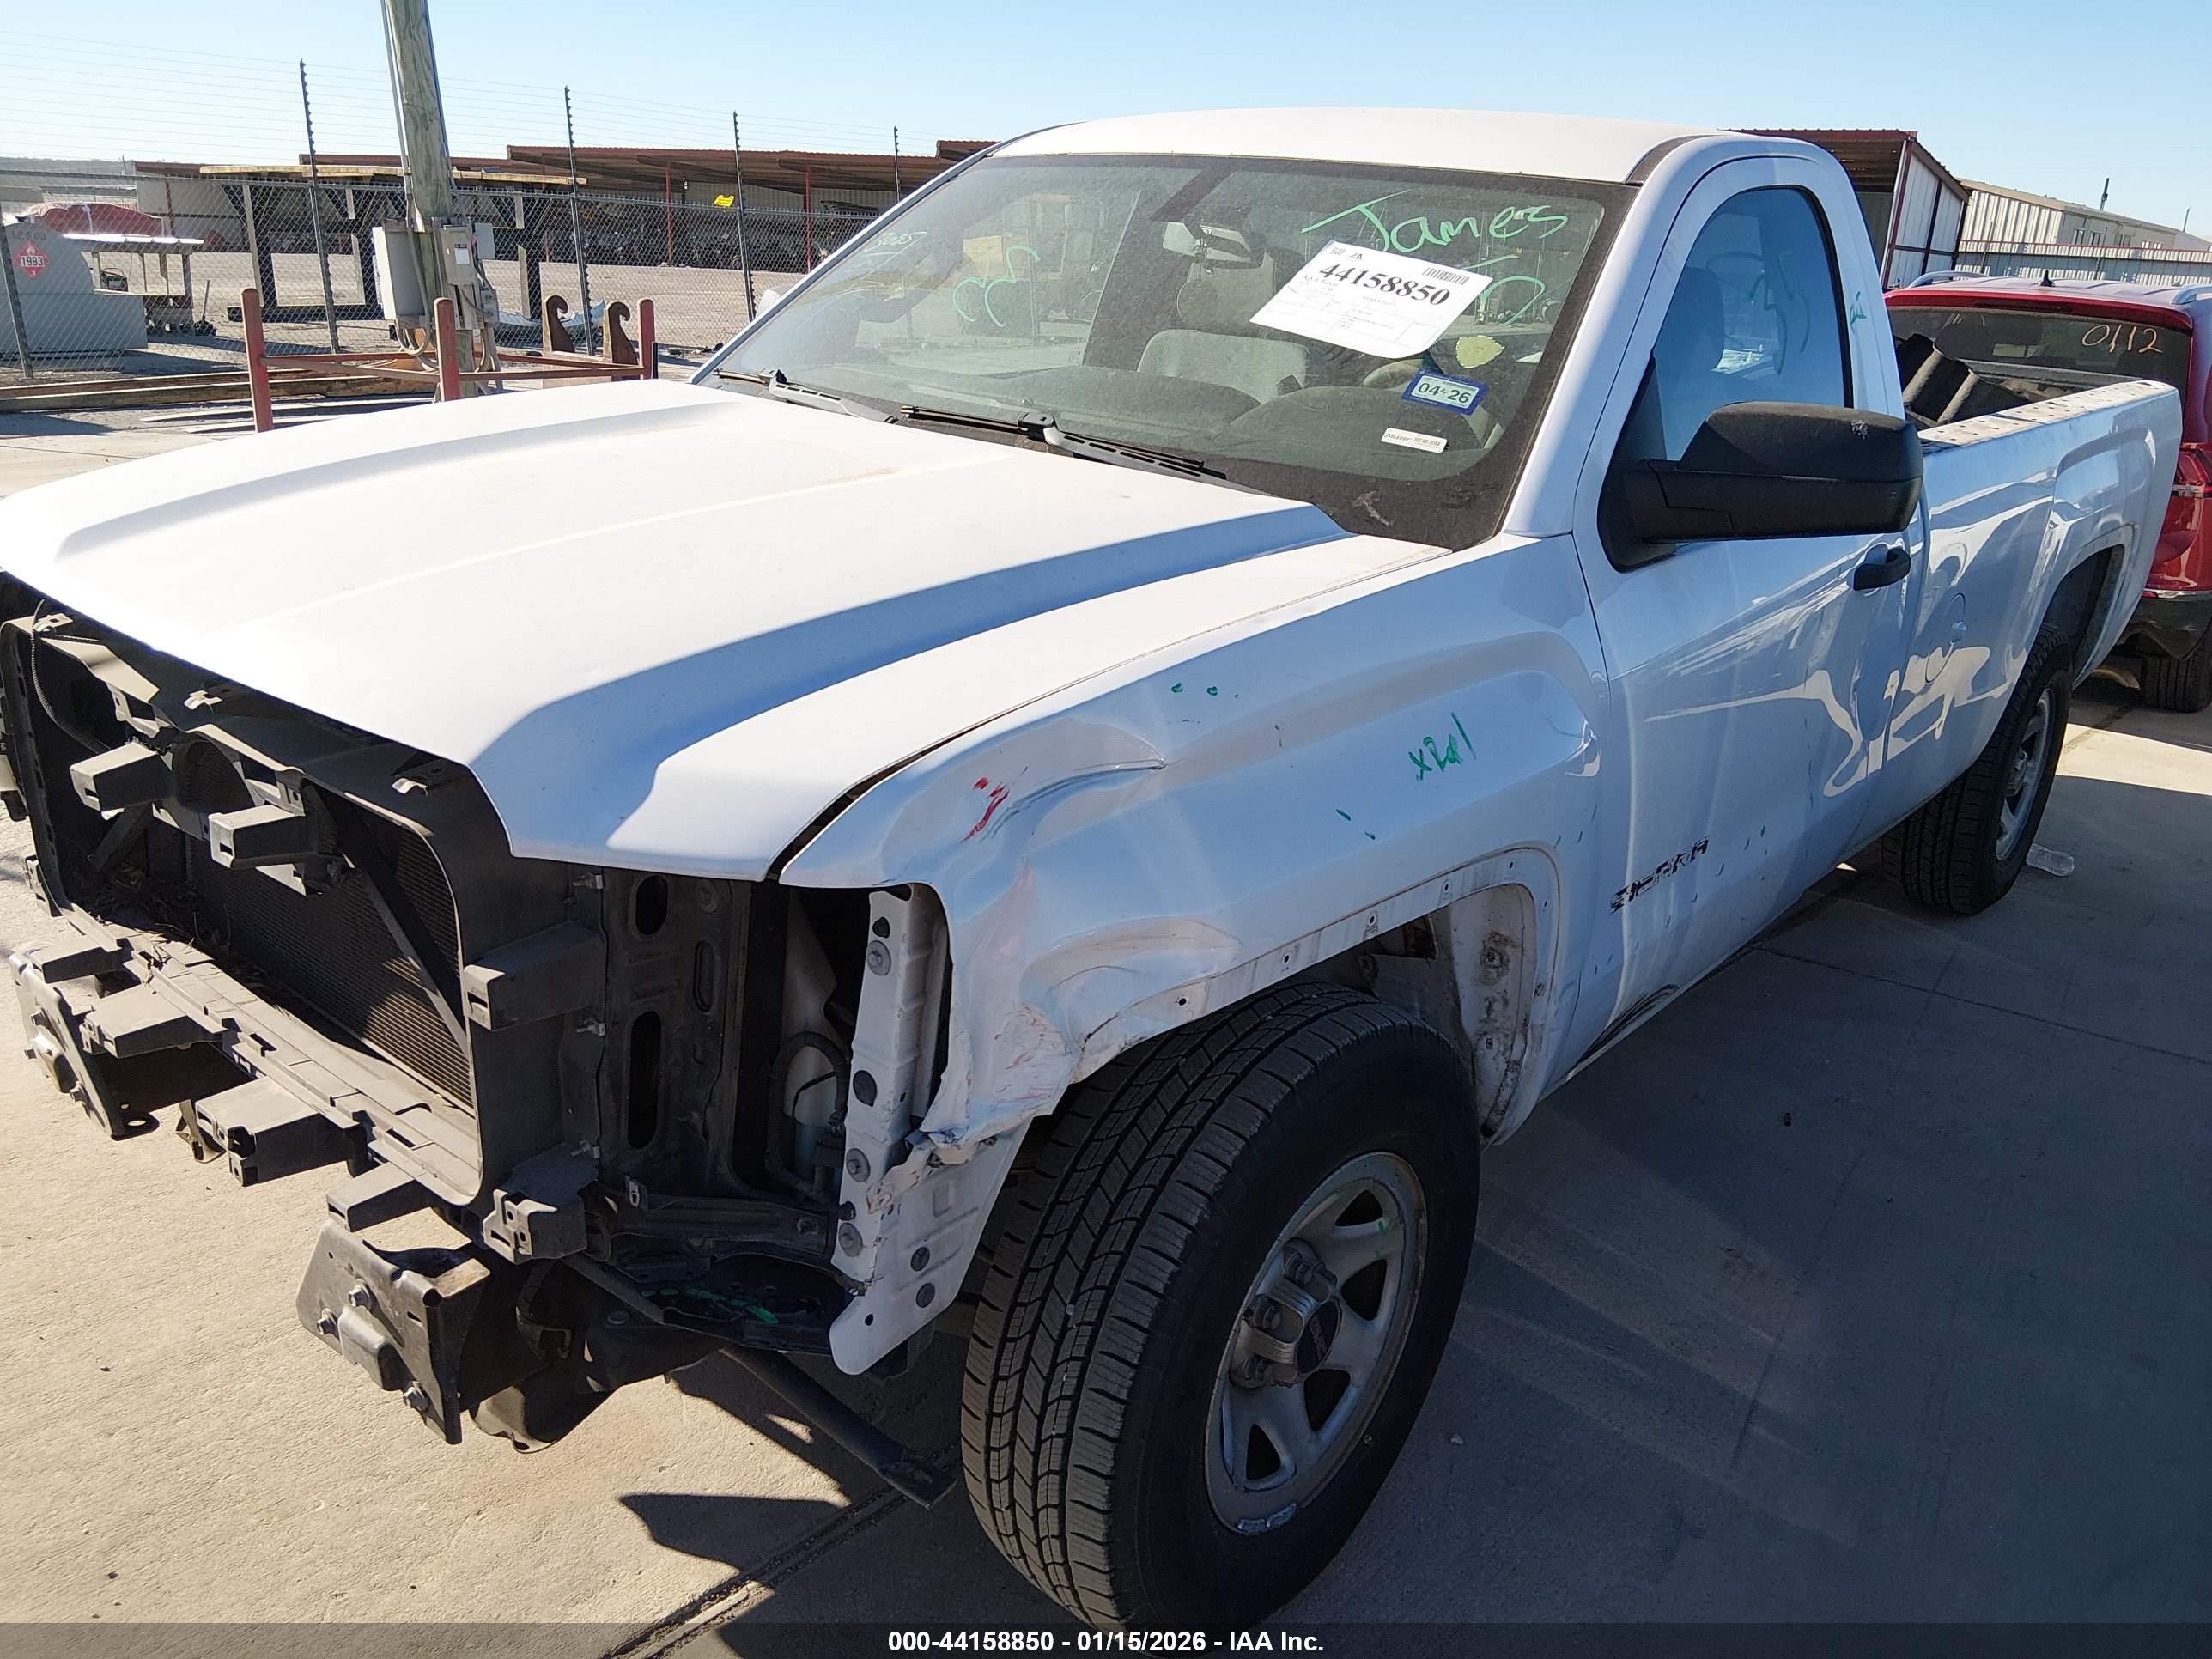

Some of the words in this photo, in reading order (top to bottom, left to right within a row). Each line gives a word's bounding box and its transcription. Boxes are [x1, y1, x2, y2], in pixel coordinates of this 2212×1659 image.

[1301, 189, 1569, 252] James
[21, 256, 44, 267] 1993
[1319, 264, 1450, 306] 44158850
[2081, 324, 2164, 354] 0112
[1418, 382, 1441, 396] 04
[1447, 389, 1471, 404] 26
